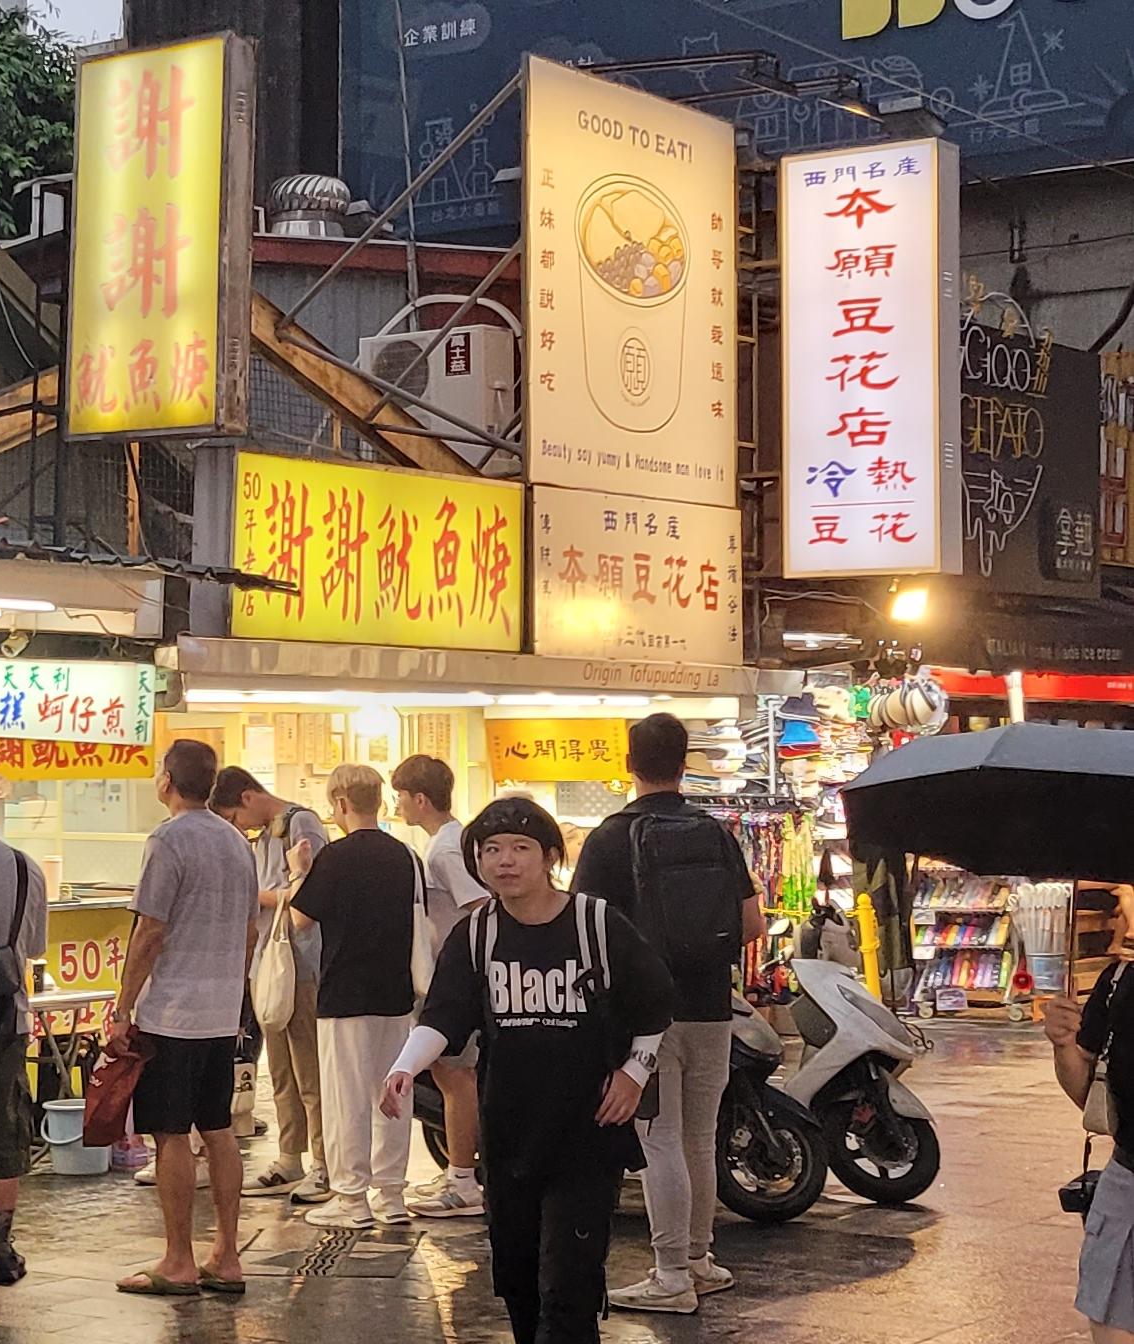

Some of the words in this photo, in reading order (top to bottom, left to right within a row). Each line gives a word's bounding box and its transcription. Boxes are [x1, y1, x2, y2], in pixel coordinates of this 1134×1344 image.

[403, 18, 476, 47] 企業訓練
[578, 109, 623, 141] GOOD
[629, 125, 650, 150] TO
[655, 133, 693, 164] EAT!
[101, 64, 196, 319] 謝謝
[807, 512, 918, 546] 豆花
[3, 665, 70, 692] 天天利
[583, 662, 622, 686] Origin
[630, 664, 701, 692] Tofupudding
[37, 694, 125, 737] 蚵仔煎
[135, 671, 152, 743] 天天利
[488, 959, 587, 1014] Black
